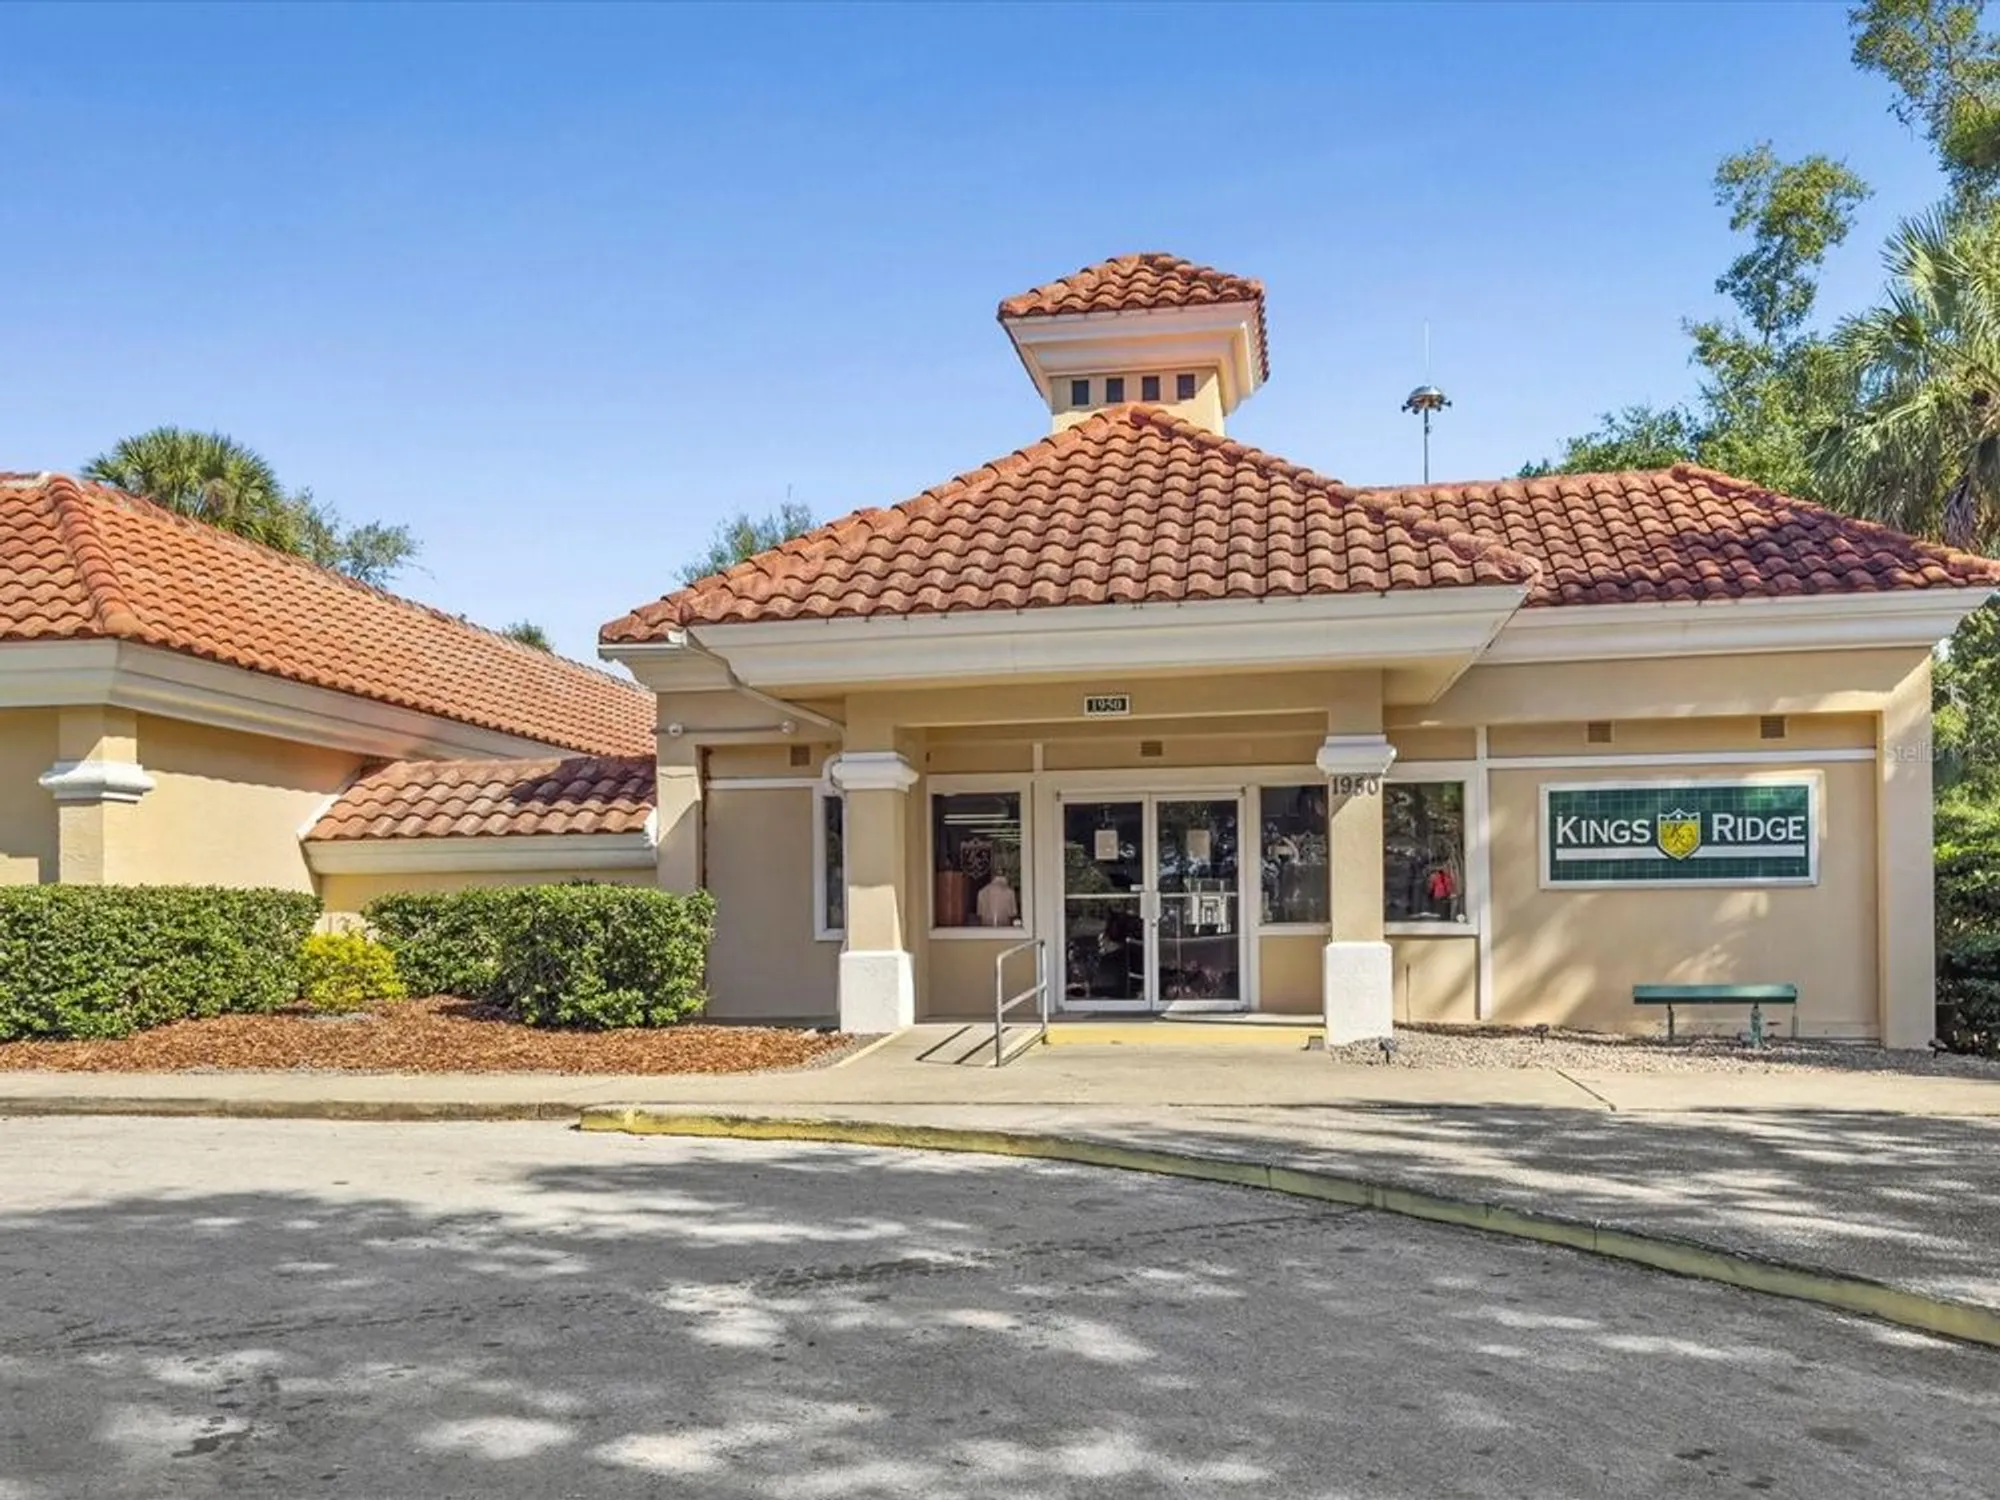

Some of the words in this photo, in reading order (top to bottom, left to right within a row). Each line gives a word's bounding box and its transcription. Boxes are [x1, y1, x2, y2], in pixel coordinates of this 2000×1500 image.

[1091, 698, 1122, 712] 1950
[1332, 775, 1380, 796] 1950
[1556, 815, 1651, 844] KINGS
[1712, 813, 1806, 842] RIDGE
